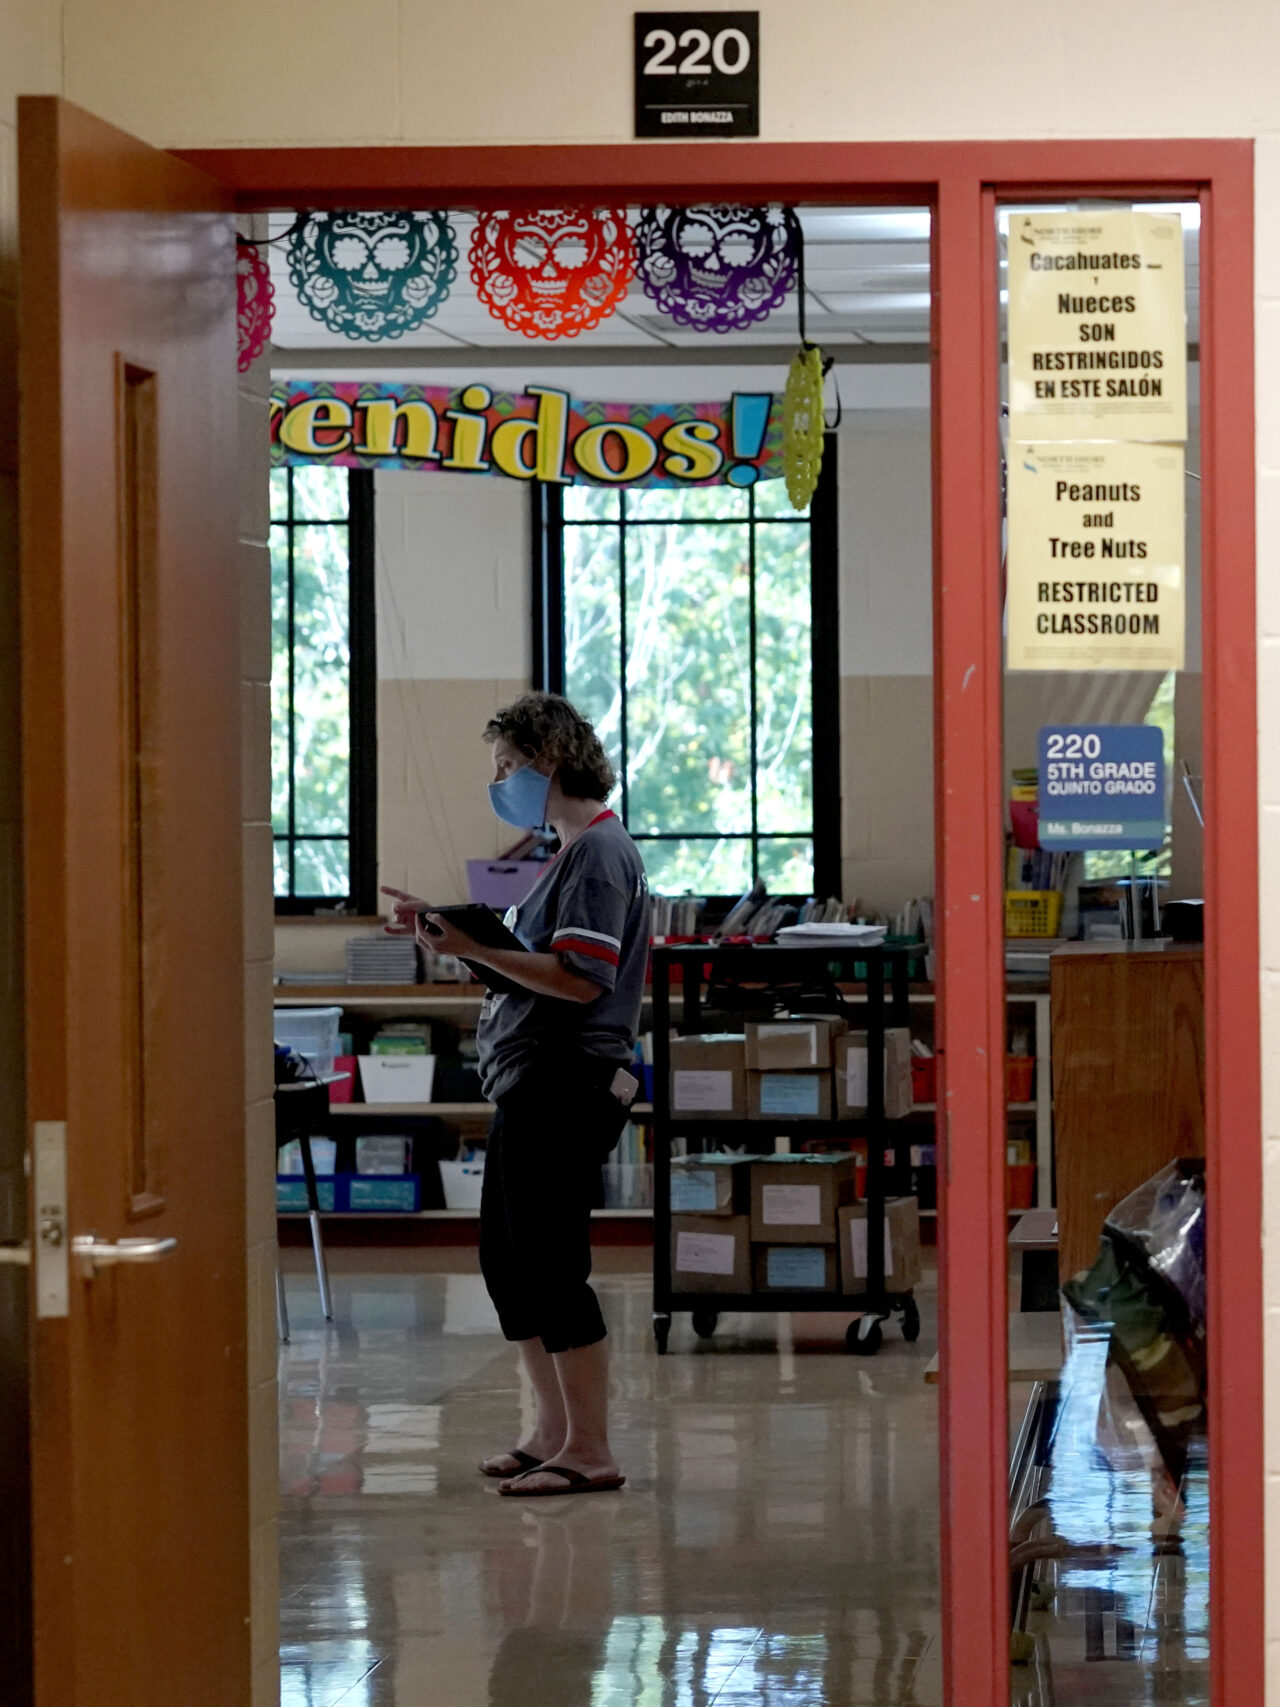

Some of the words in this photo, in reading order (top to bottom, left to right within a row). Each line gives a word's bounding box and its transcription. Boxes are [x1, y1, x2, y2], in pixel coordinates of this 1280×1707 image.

[643, 28, 750, 75] 220
[660, 111, 689, 123] EDITH
[690, 111, 734, 123] BONAZZA
[1030, 252, 1141, 271] Cacahuates
[1058, 293, 1136, 314] Nueces
[1079, 323, 1115, 342] SON
[1033, 351, 1163, 371] RESTRINGIDOS
[1035, 381, 1055, 398] EN
[1061, 380, 1100, 398] ESTE
[1107, 373, 1162, 398] SALÓN
[270, 385, 773, 487] enidos!
[1056, 480, 1141, 502] Peanuts
[1083, 511, 1114, 528] and
[1049, 537, 1095, 559] Tree
[1101, 537, 1148, 559] Nuts
[1037, 582, 1158, 603] RESTRICTED
[1036, 613, 1159, 635] CLASSROOM
[1046, 734, 1101, 759] 220
[1047, 762, 1084, 780] 5TH
[1089, 762, 1157, 779] GRADE
[1047, 781, 1101, 795] QUINTO
[1104, 780, 1156, 795] GRADO
[1047, 822, 1068, 835] Ms.
[1071, 822, 1123, 835] Bonazza
